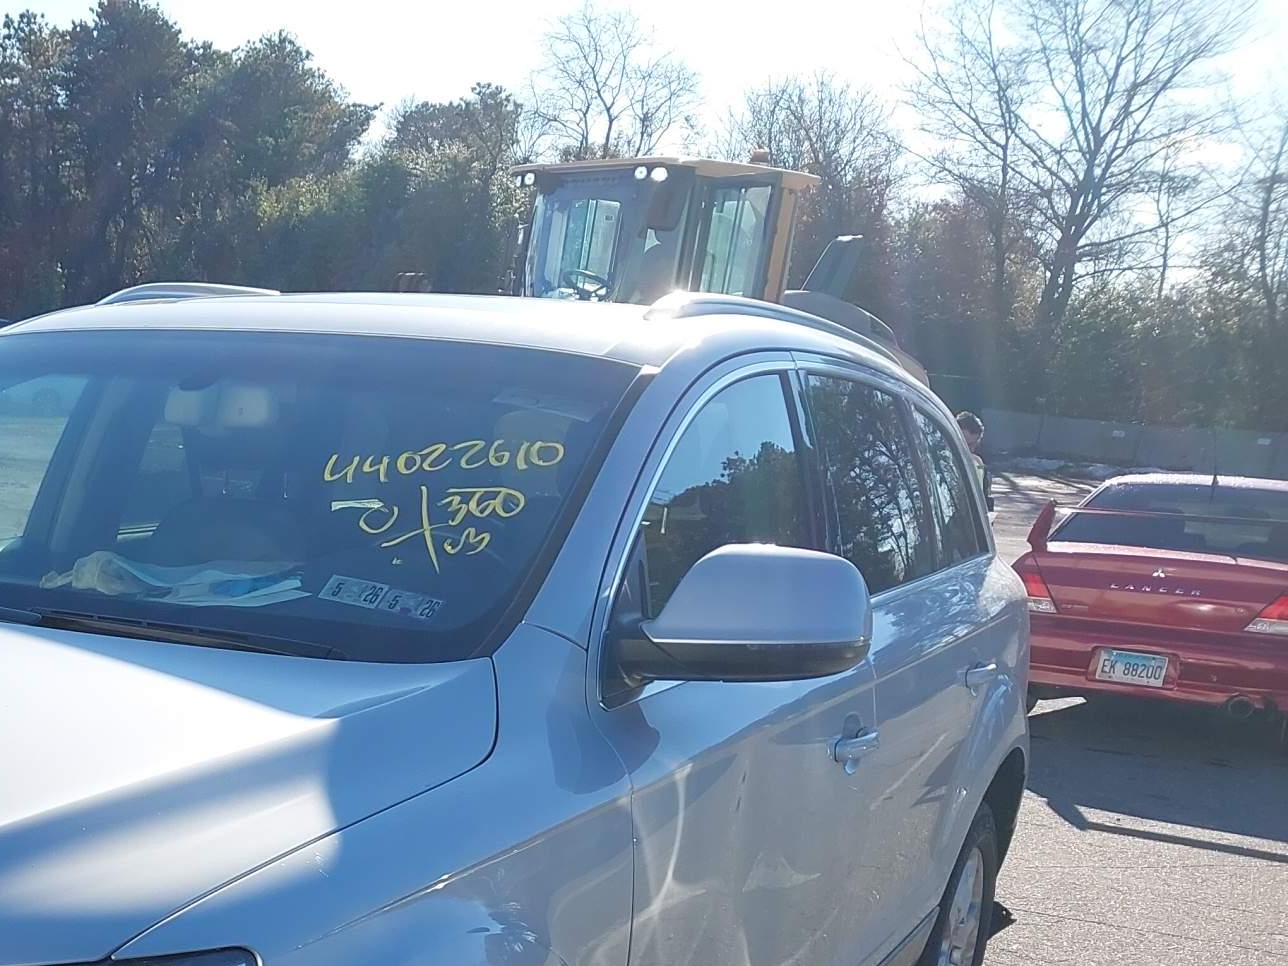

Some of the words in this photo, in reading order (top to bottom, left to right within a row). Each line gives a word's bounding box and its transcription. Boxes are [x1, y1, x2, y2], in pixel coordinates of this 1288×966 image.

[324, 439, 565, 483] 44022610
[331, 582, 344, 597] 5
[362, 585, 384, 604] 26
[1110, 583, 1201, 596] LANCER
[388, 595, 402, 610] 5
[419, 599, 441, 617] 26
[1100, 658, 1117, 675] EK
[1122, 661, 1163, 680] 88200
